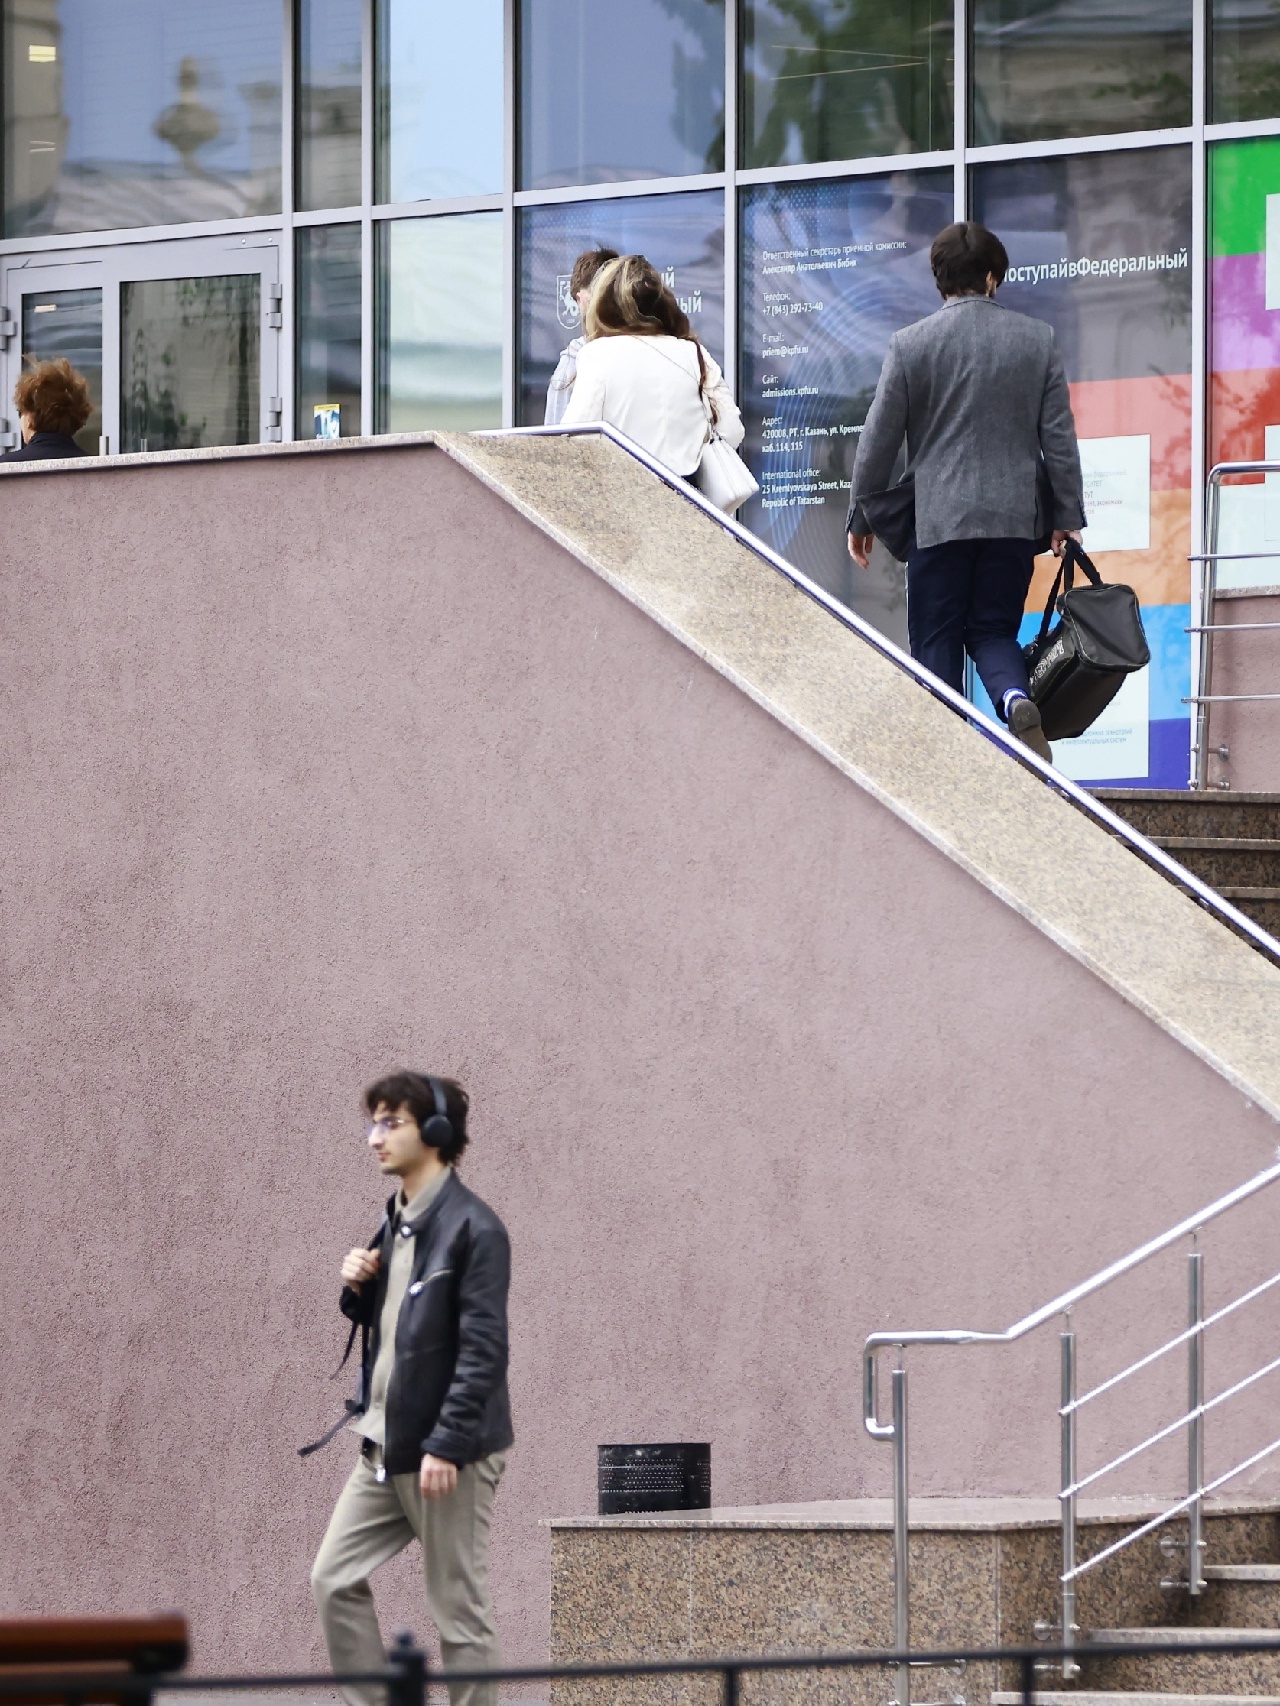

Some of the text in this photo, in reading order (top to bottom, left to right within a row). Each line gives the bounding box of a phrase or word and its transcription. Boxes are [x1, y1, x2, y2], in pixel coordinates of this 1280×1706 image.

[762, 248, 809, 261] Ответственный
[810, 247, 842, 258] секретарь
[762, 264, 796, 275] Александр
[797, 260, 837, 272] Анатольевич
[762, 292, 791, 302] Телефон:
[762, 301, 824, 317] +7 (843) 292-73-40
[762, 332, 785, 343] E-mail:
[762, 374, 780, 385] Сайт:
[762, 385, 819, 398] admissions.kpfu.ru
[762, 416, 783, 428] Адрес:
[805, 426, 829, 437] Казань,
[839, 424, 866, 437] Кремле
[762, 467, 822, 480] International office:
[762, 485, 771, 495] 25
[818, 480, 839, 491] Street,
[762, 498, 789, 510] Republic
[796, 496, 827, 506] Tatarstan
